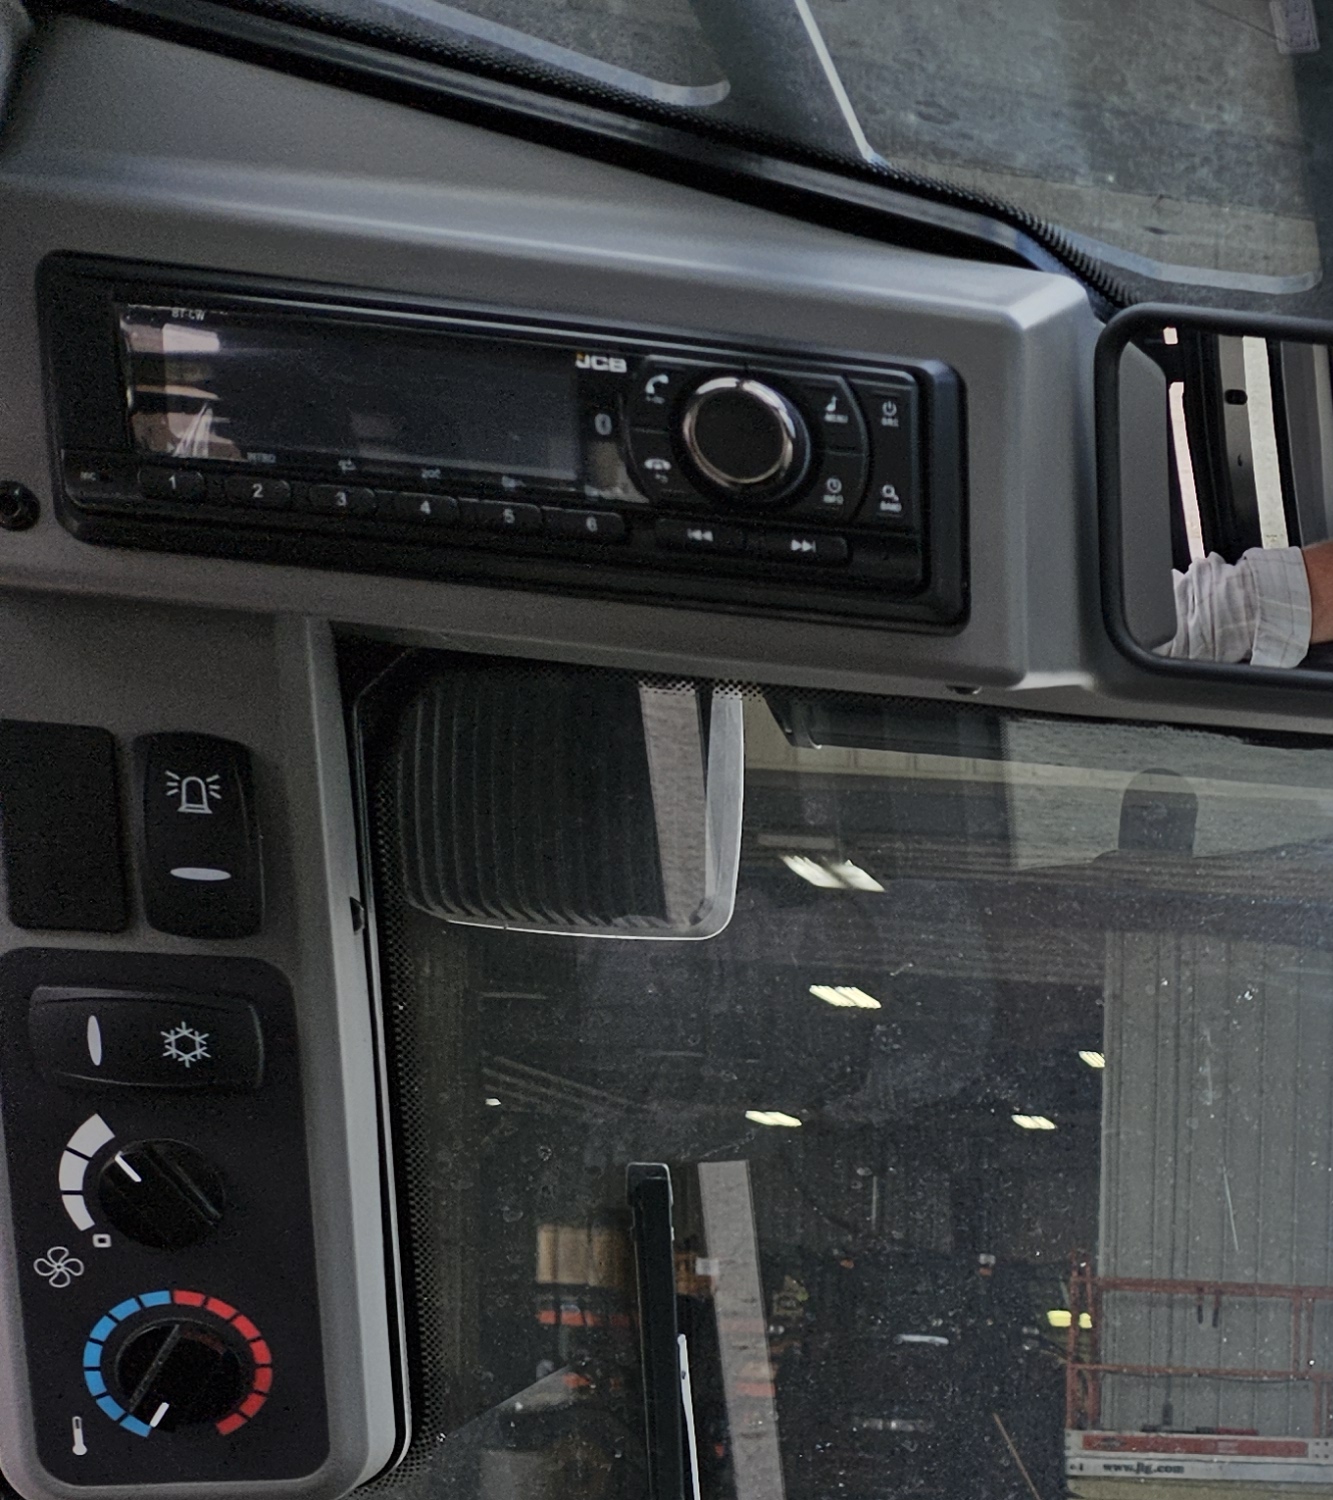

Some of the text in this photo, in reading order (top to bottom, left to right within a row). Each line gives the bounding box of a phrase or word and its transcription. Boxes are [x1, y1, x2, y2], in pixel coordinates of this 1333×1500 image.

[574, 352, 628, 373] JCB
[168, 474, 177, 490] 1
[252, 483, 264, 498] 2
[334, 491, 347, 507] 3
[420, 500, 431, 515] 4
[503, 508, 515, 524] 5
[586, 516, 598, 532] 6
